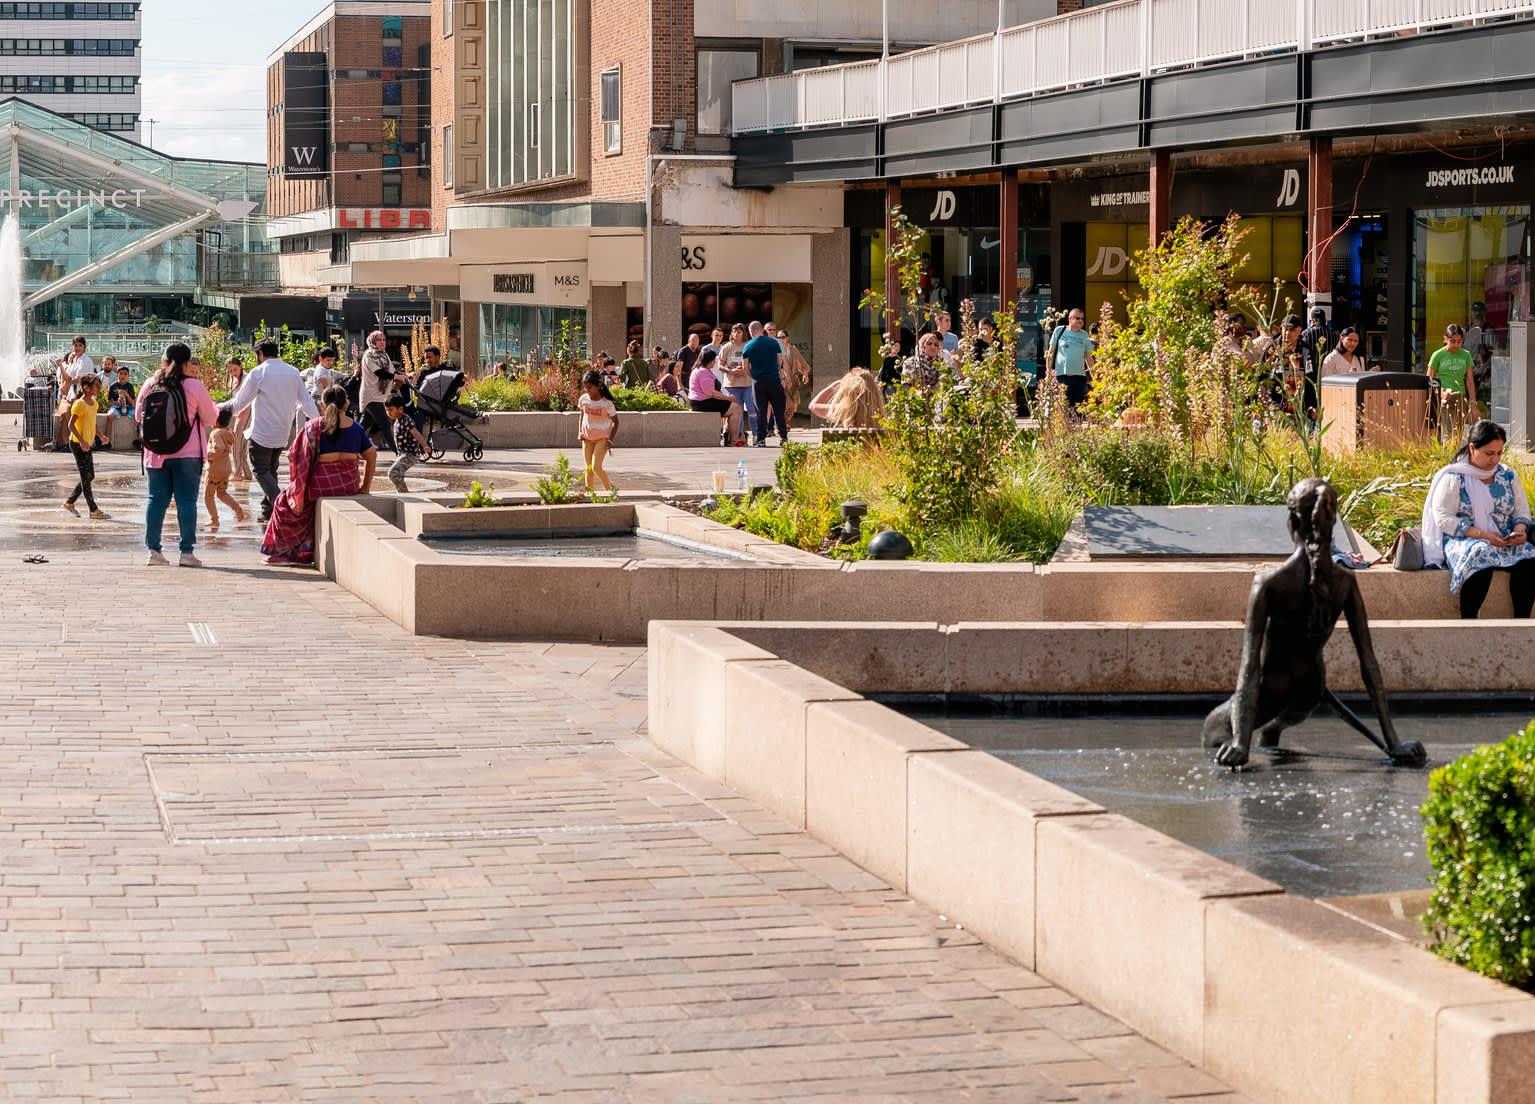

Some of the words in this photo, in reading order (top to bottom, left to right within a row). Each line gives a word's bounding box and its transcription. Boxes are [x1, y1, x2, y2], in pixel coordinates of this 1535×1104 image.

[291, 146, 318, 166] W
[1425, 164, 1515, 188] JDSPORTS.CO.UK
[0, 187, 147, 209] PRECINCT
[1100, 192, 1116, 206] KING
[1123, 190, 1151, 205] TRAINER
[1276, 168, 1301, 208] JD
[929, 189, 957, 222] JD
[339, 209, 431, 228] LIBR
[680, 245, 706, 271] &S
[1086, 246, 1128, 277] JD
[554, 275, 580, 286] M&S
[374, 310, 432, 324] Waterston
